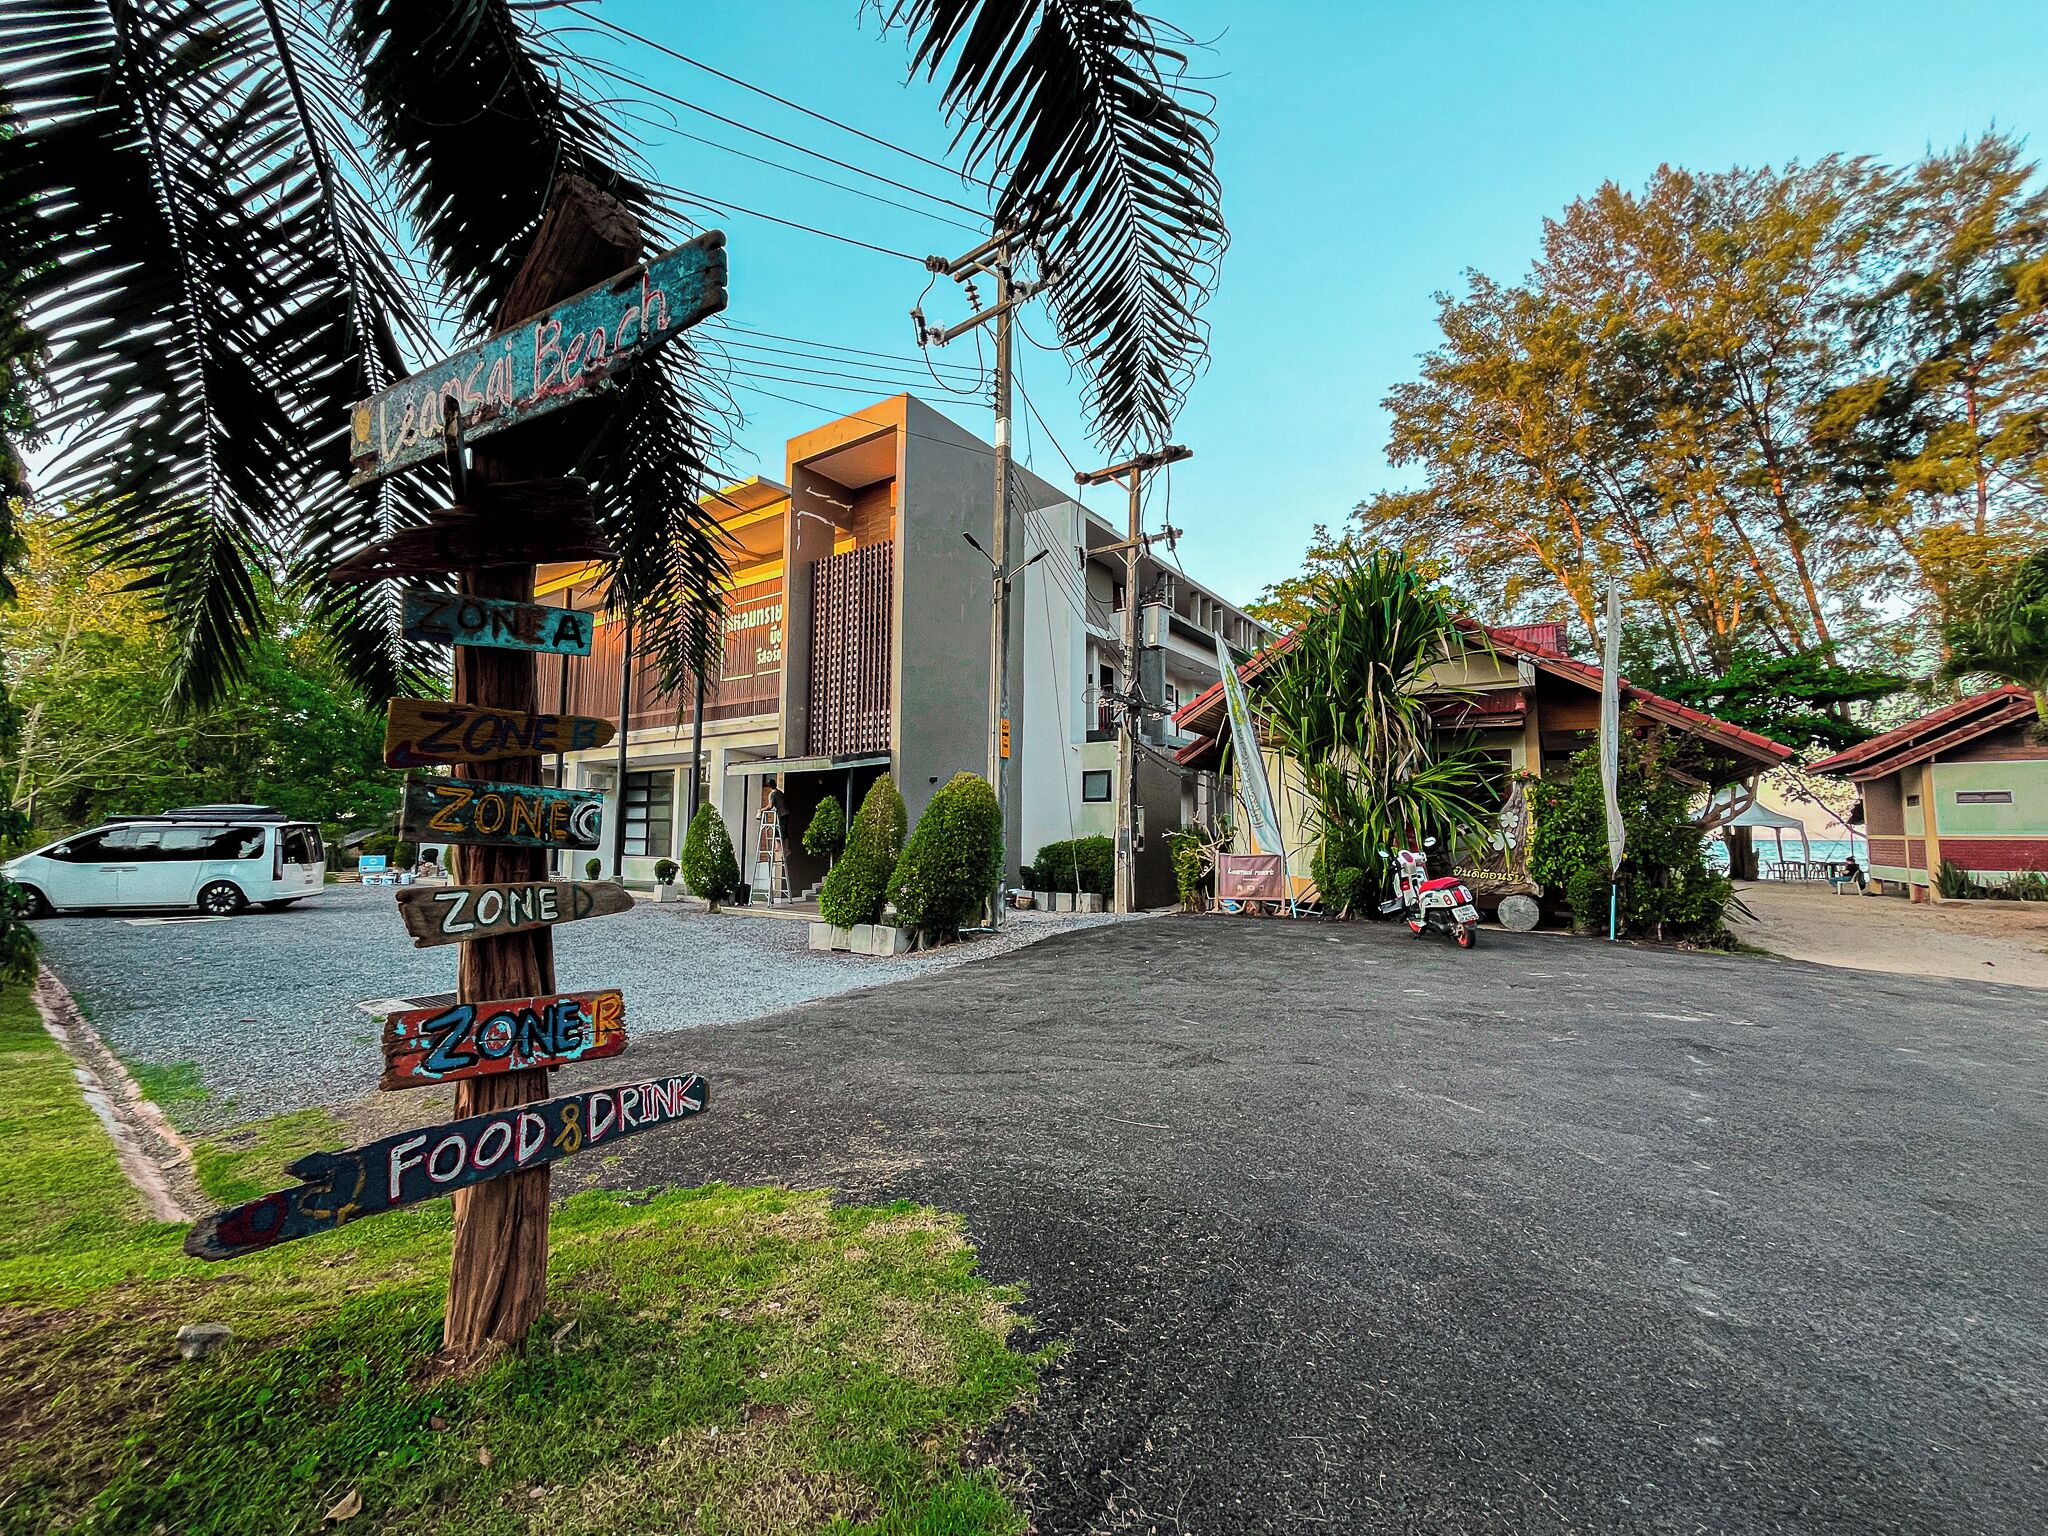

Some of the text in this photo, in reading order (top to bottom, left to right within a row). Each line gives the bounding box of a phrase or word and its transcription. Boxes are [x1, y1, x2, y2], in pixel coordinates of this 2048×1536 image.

[529, 266, 671, 404] Beach
[417, 599, 586, 649] ZONE A
[417, 711, 599, 755] ZONE B
[428, 786, 603, 842] ZONE C
[434, 884, 594, 935] ZONE D
[421, 993, 623, 1074] ZONE R
[388, 1111, 549, 1204] FOOD
[586, 1073, 704, 1143] DRINK
